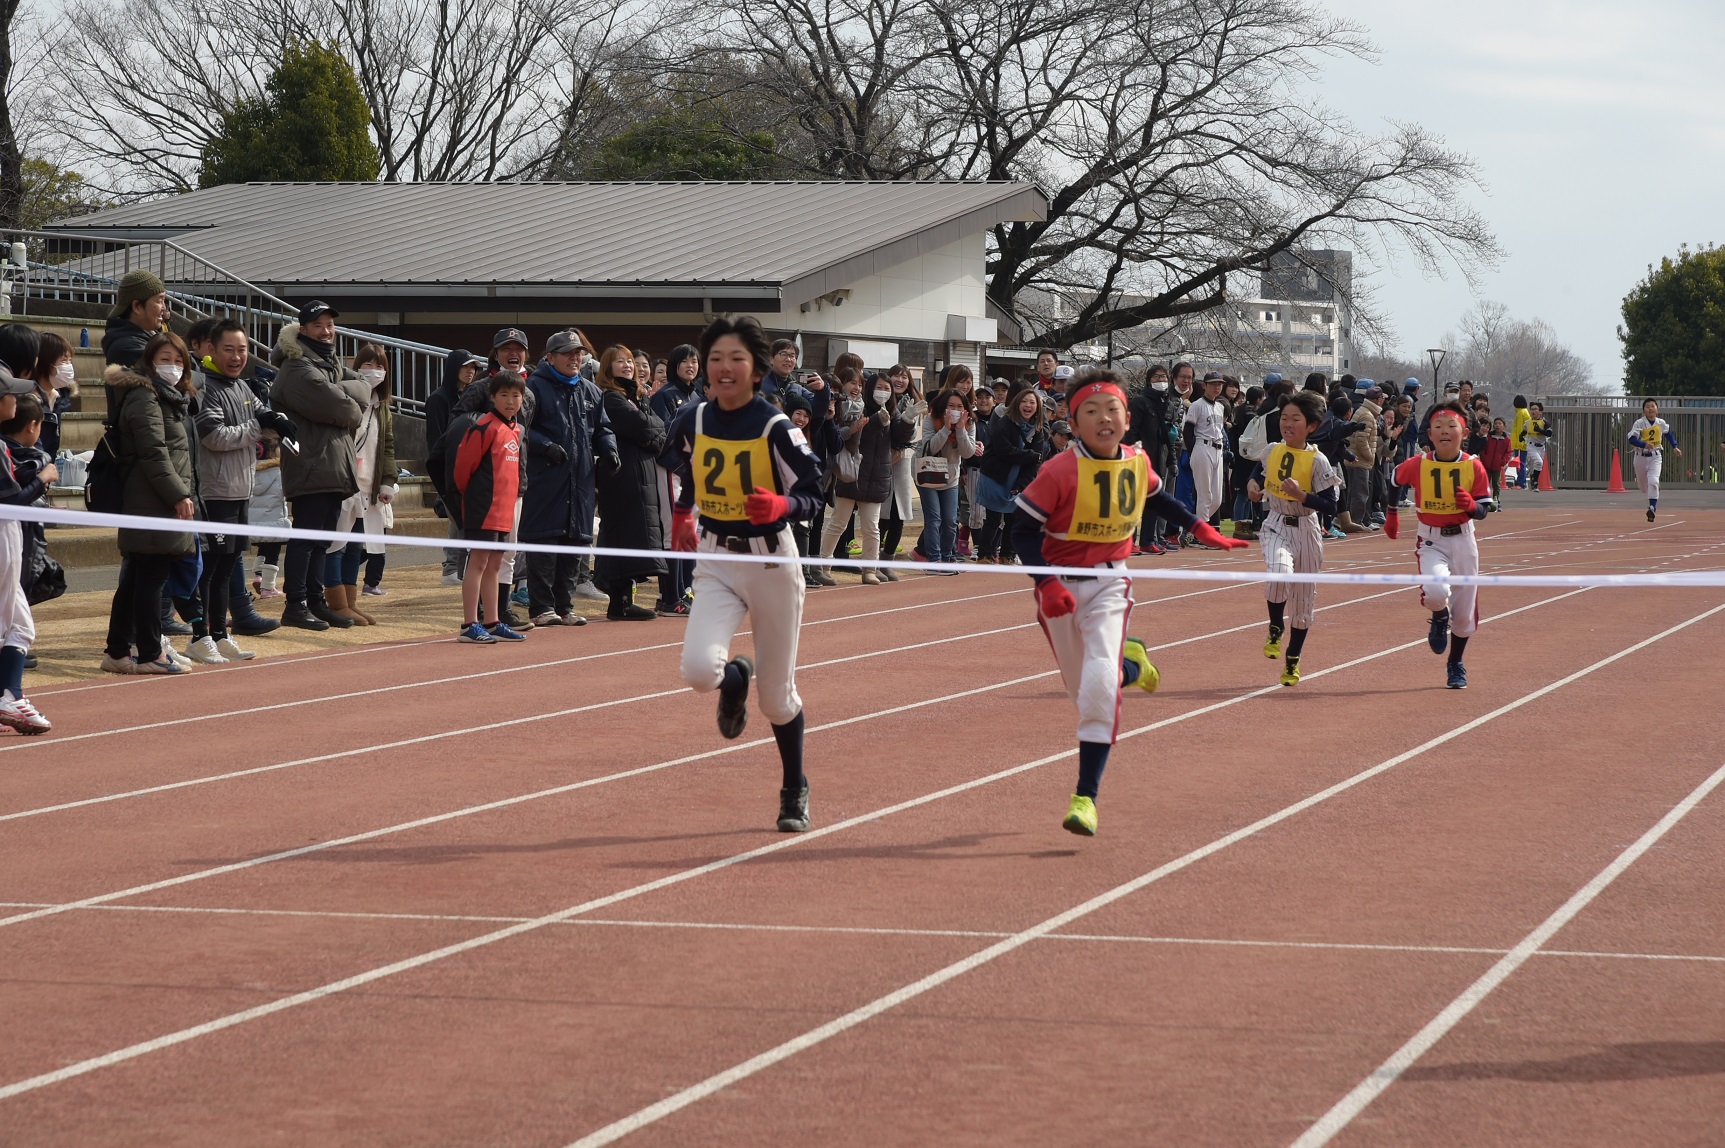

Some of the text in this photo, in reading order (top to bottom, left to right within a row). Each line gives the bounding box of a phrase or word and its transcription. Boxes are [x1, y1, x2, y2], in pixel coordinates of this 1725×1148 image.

[1649, 429, 1655, 441] 2
[703, 448, 754, 497] 21
[1278, 452, 1294, 481] 9
[1094, 468, 1136, 518] 10
[1431, 468, 1461, 499] 11
